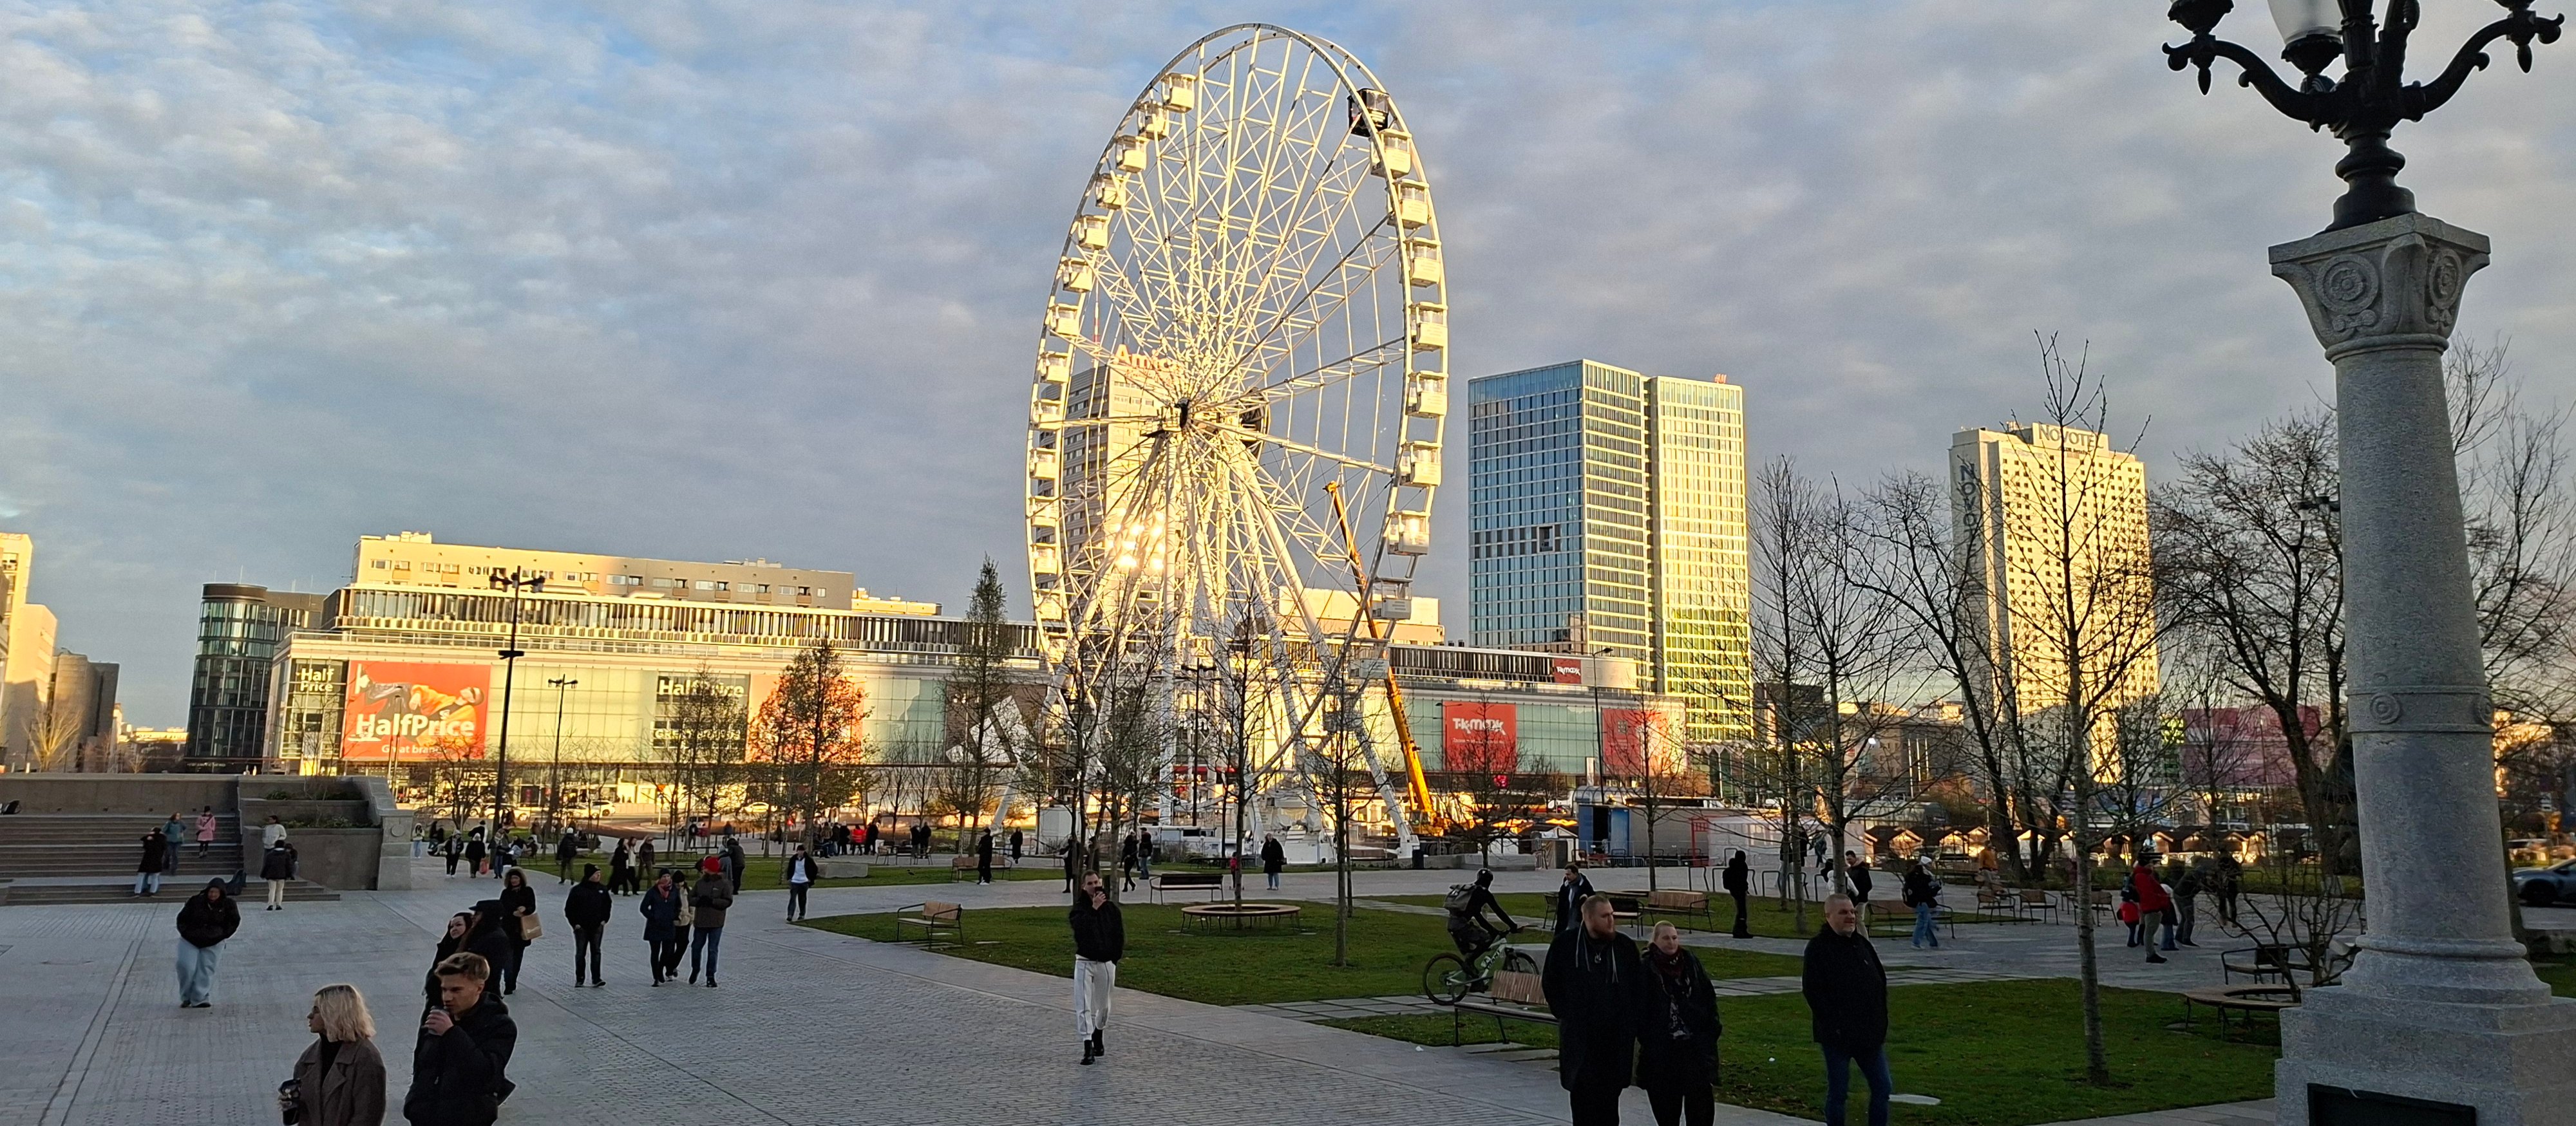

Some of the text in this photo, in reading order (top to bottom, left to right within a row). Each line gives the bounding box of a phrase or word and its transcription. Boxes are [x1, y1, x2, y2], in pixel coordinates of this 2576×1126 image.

[1115, 344, 1180, 372] Amic
[301, 668, 334, 681] Half
[300, 680, 334, 692] Price
[356, 713, 475, 737] HalfPrice
[381, 744, 410, 754] Gat
